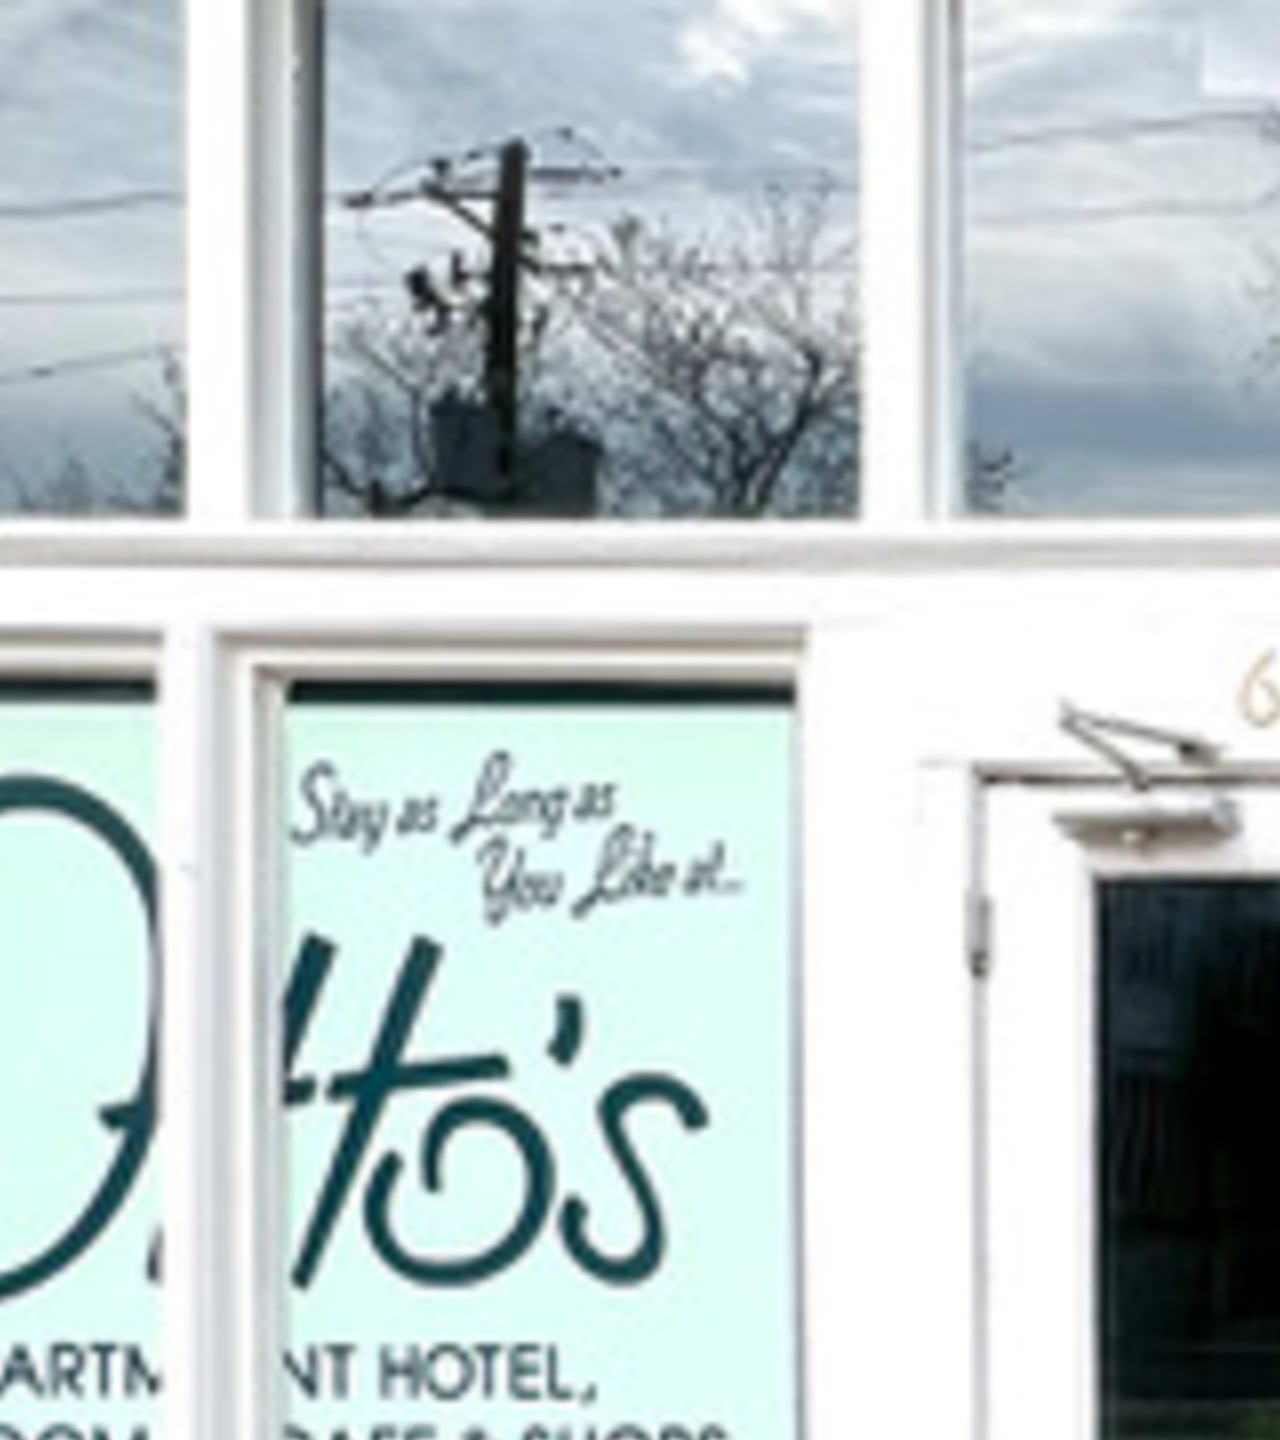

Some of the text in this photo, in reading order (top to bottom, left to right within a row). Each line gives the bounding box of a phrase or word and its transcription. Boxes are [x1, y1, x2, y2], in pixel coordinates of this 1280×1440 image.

[289, 751, 616, 854] Stay as Long as
[477, 834, 564, 925] You
[571, 822, 676, 918] Like
[379, 1344, 597, 1403] HOTEL,
